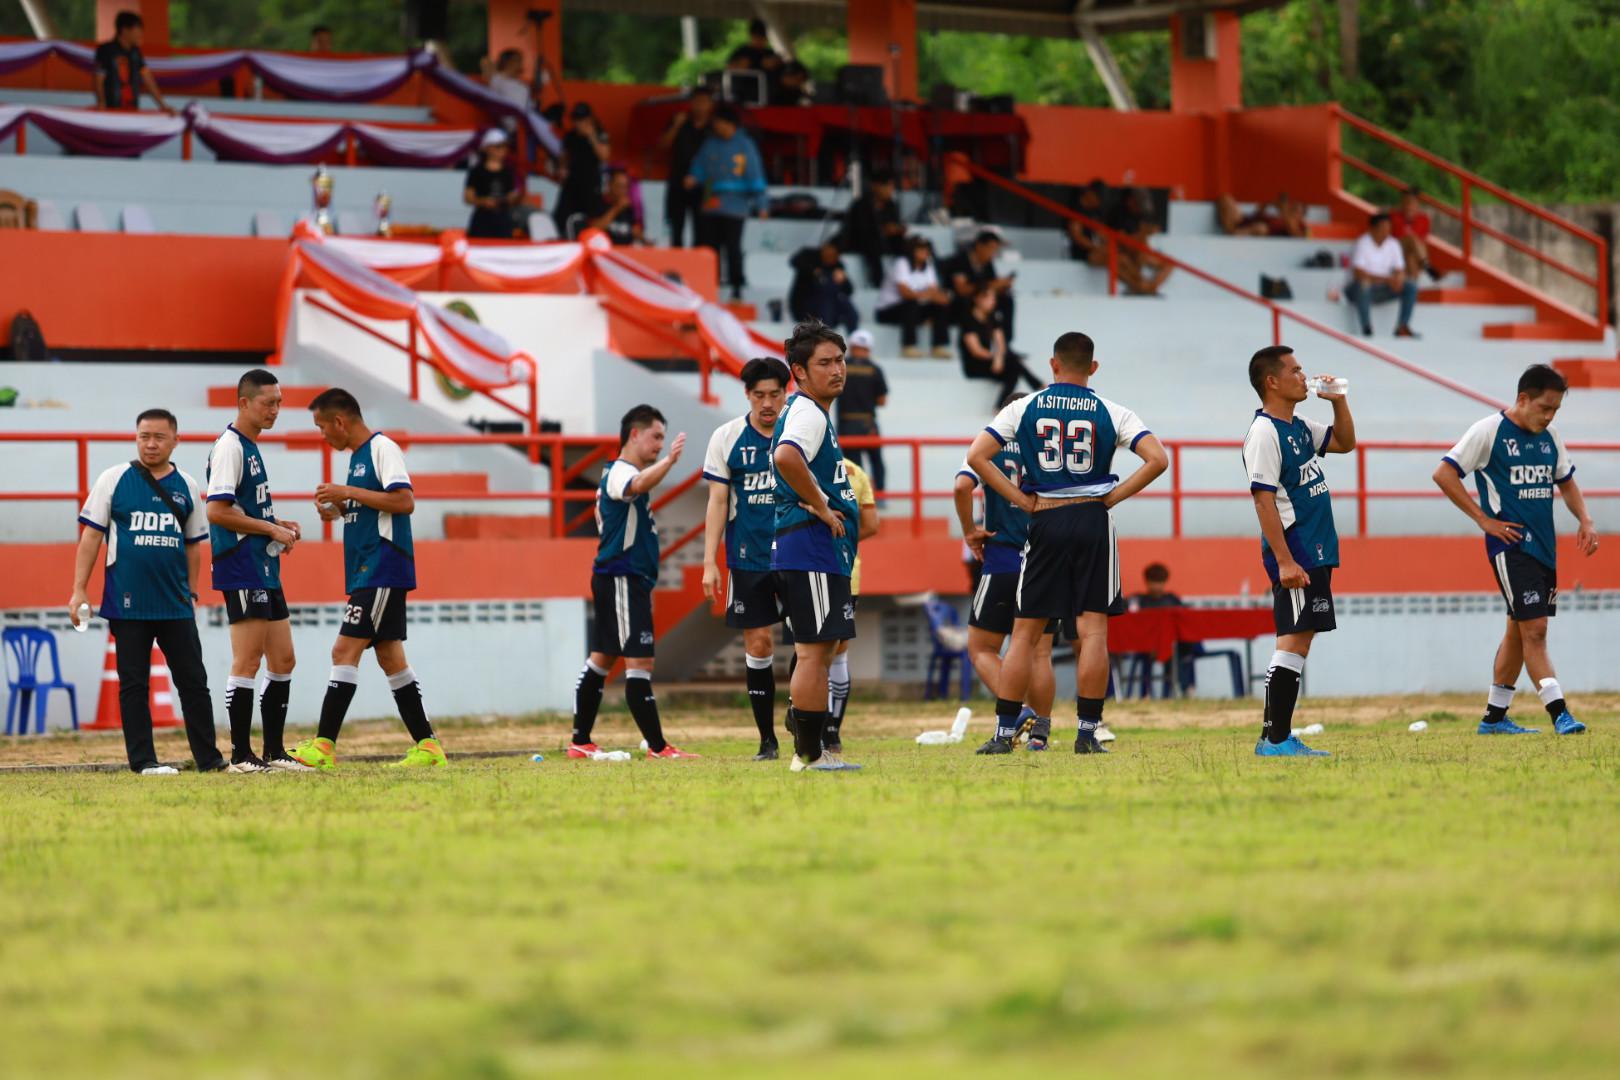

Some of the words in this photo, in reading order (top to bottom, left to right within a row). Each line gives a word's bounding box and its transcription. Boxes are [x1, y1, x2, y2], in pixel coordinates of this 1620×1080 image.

[739, 446, 757, 466] 17
[1035, 417, 1096, 475] 33
[1502, 438, 1521, 457] 12
[342, 604, 363, 625] 23
